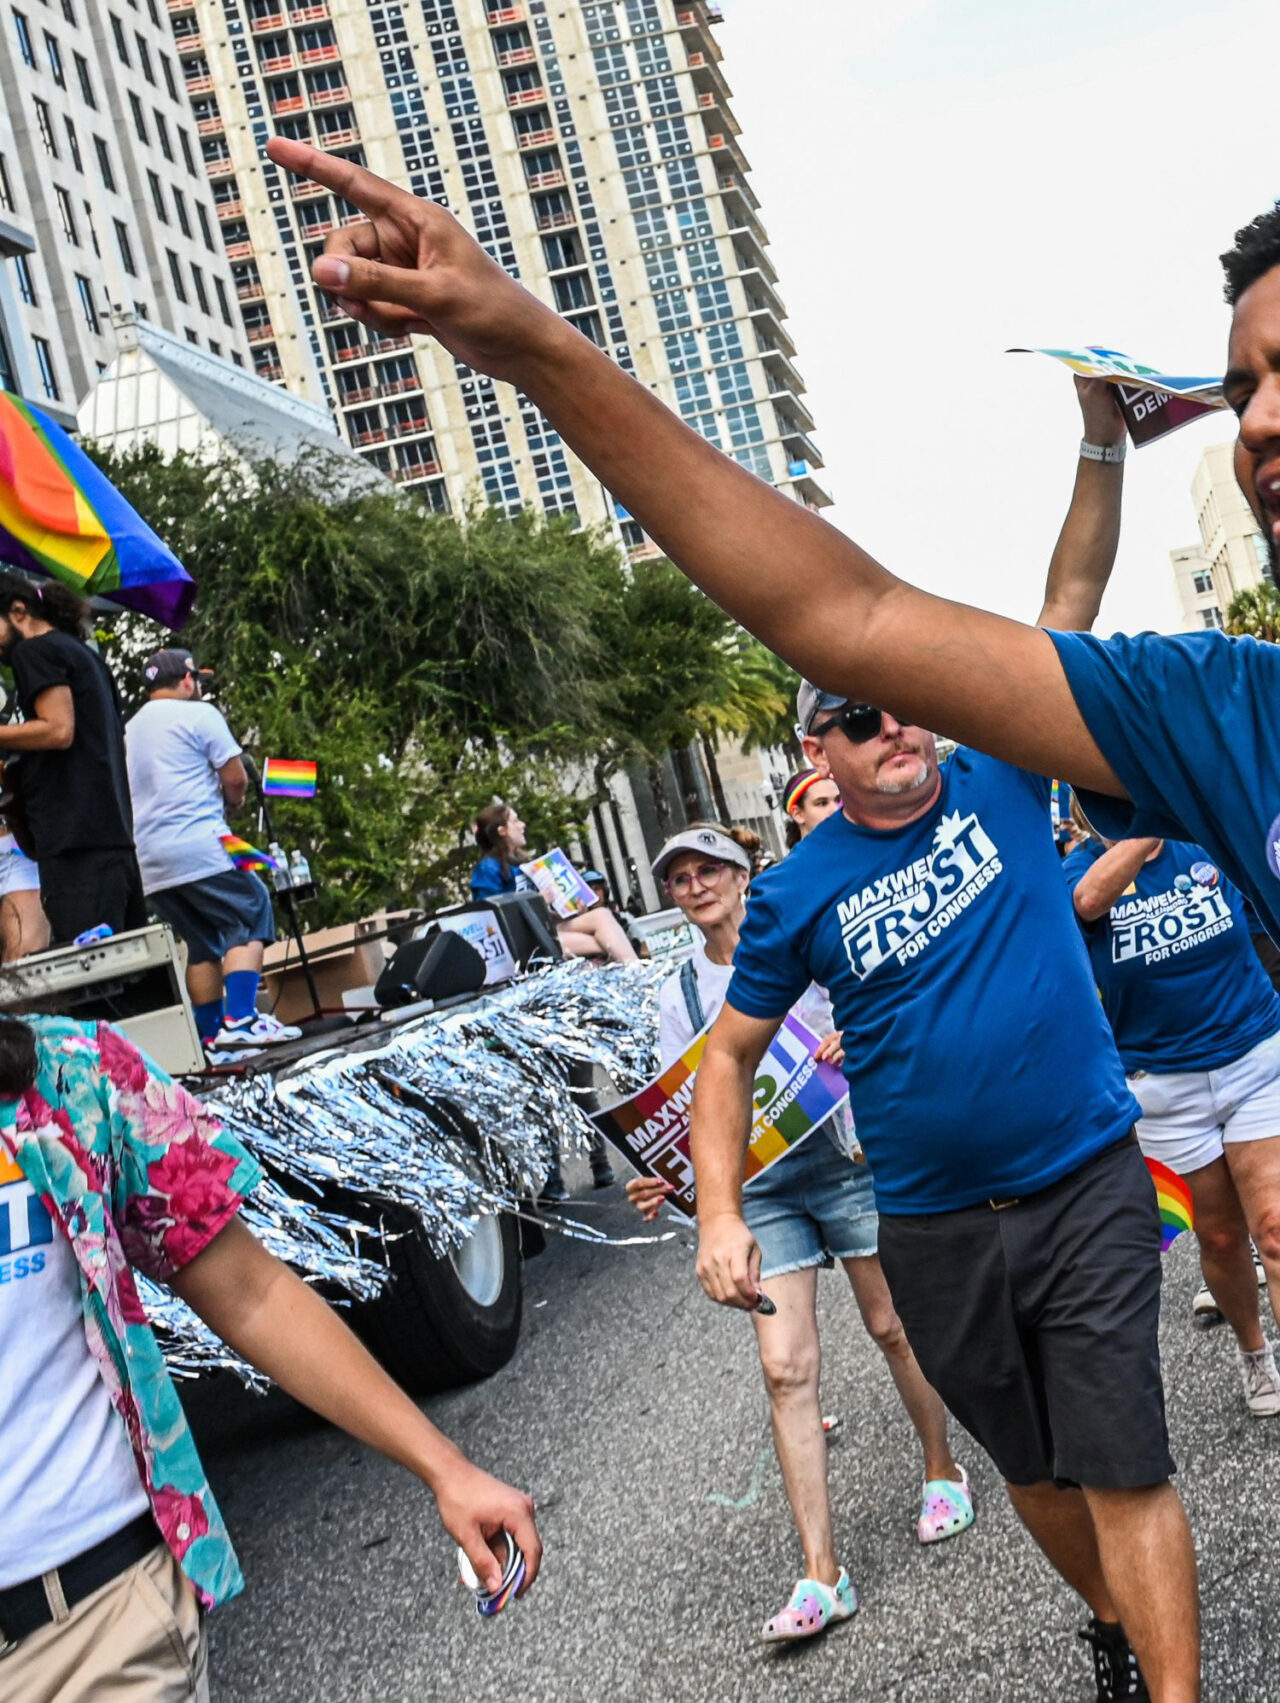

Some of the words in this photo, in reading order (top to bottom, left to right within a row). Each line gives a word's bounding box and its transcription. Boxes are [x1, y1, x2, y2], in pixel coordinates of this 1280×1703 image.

[837, 849, 935, 926] MAXWE
[848, 819, 985, 976] FROST
[896, 931, 930, 966] FOR
[927, 857, 1003, 937] CONGRESS
[1110, 888, 1186, 919] MAXWELL
[1113, 890, 1222, 960] FROST
[1145, 948, 1171, 965] FOR
[1171, 916, 1234, 954] CONGRESS
[624, 1068, 698, 1153] MAXWE
[762, 1056, 819, 1128] CONGRESS
